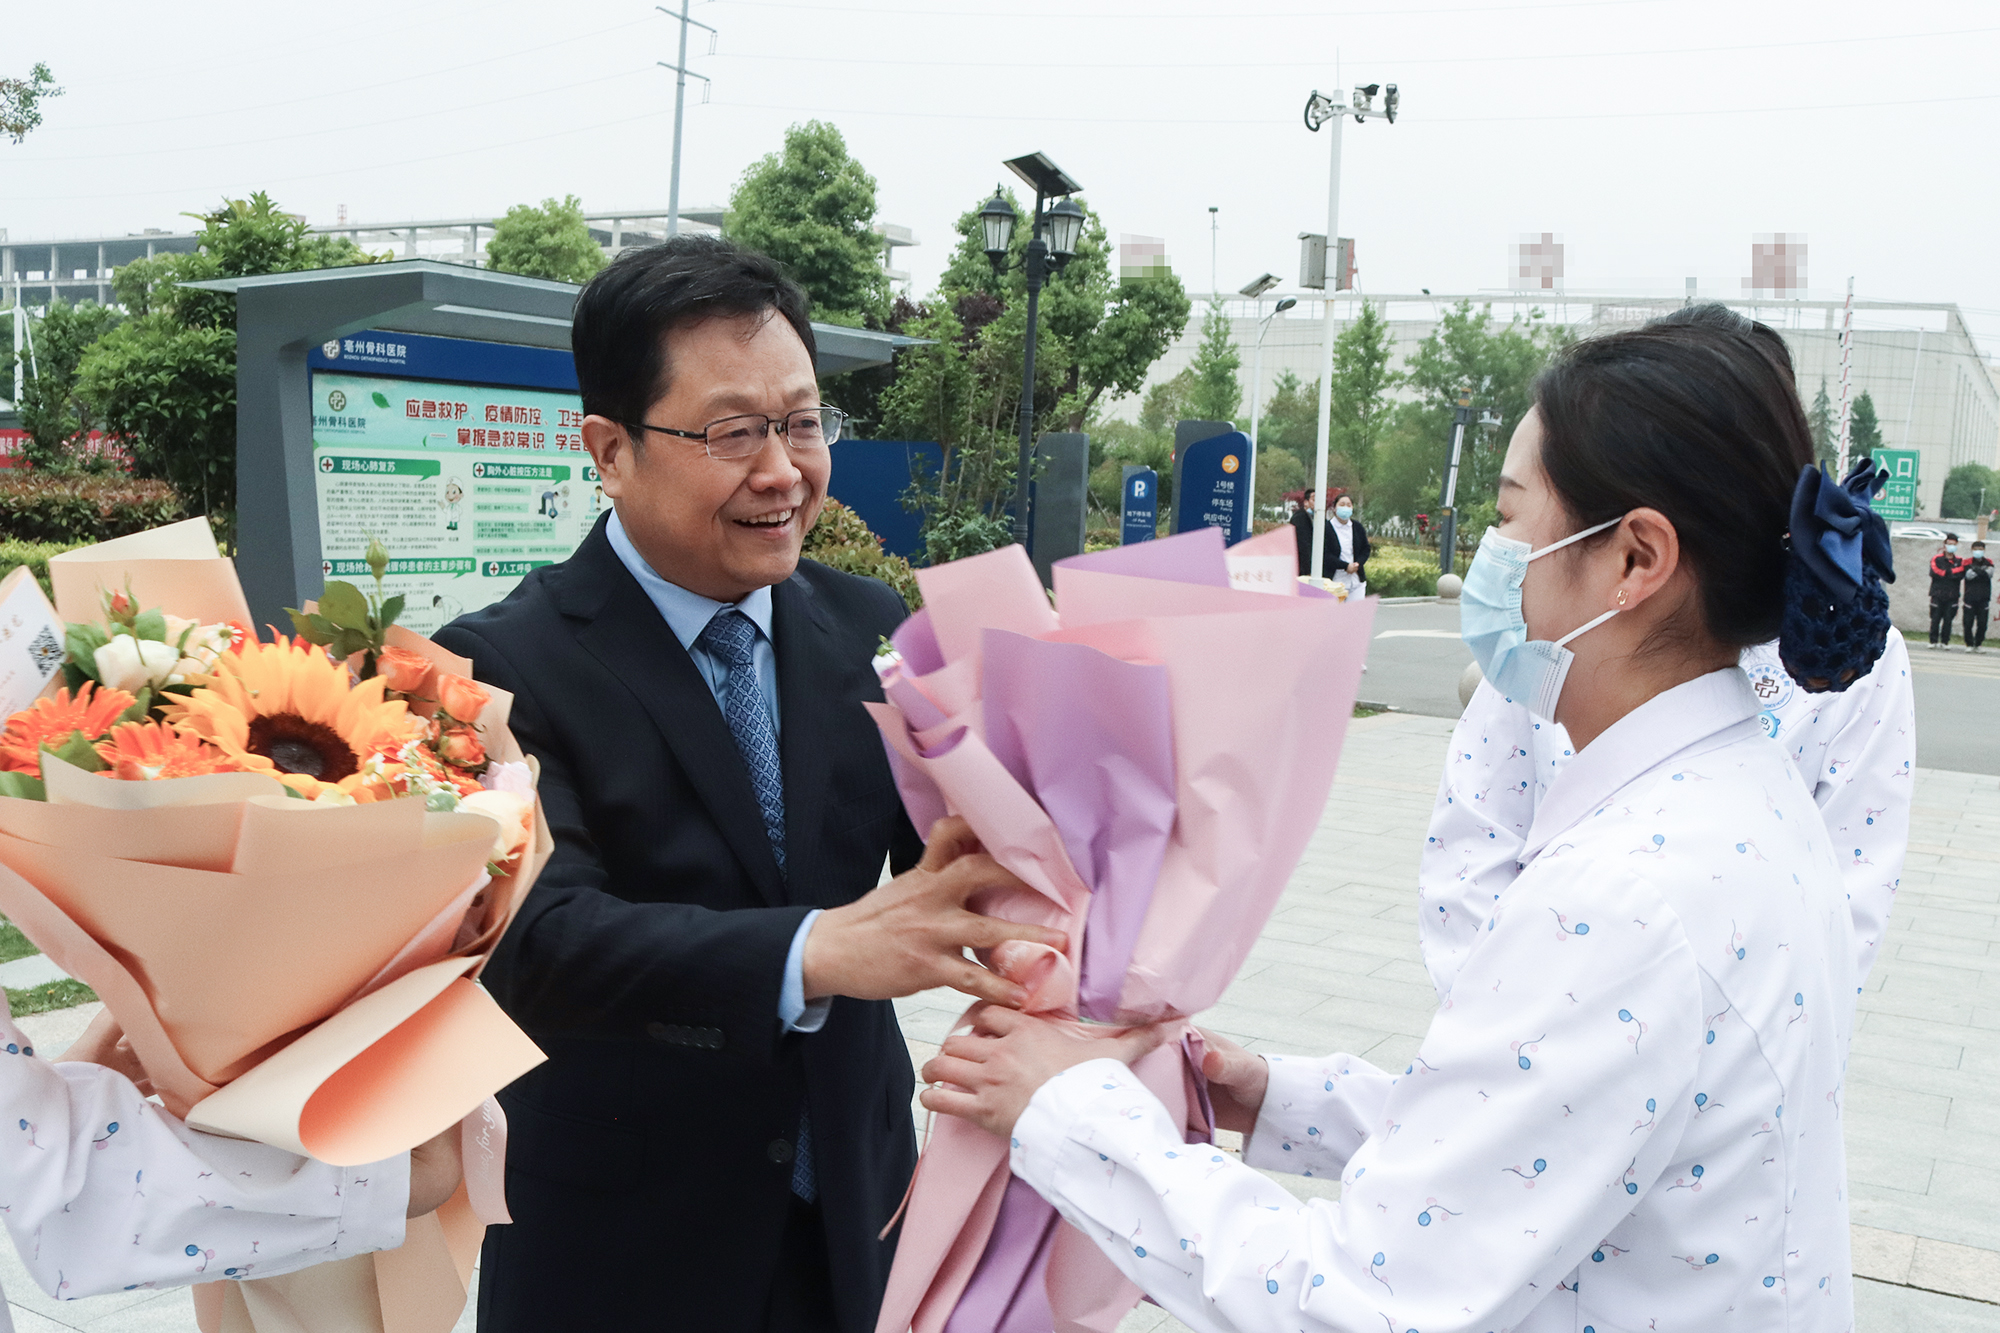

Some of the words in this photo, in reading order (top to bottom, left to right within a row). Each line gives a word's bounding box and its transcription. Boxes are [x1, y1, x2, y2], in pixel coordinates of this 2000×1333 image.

[343, 339, 407, 358] 亳州骨科医院
[457, 428, 545, 450] 掌握急救常识
[555, 433, 589, 452] 学会
[341, 460, 396, 473] 现场心肺复苏
[486, 465, 553, 478] 胸外心脏按压方法是
[1875, 455, 1913, 478] 入口
[1134, 480, 1145, 497] P
[1216, 481, 1234, 489] 1号楼
[1212, 499, 1233, 508] 停车场
[1204, 513, 1232, 523] 供应中心
[475, 1125, 494, 1159] for
